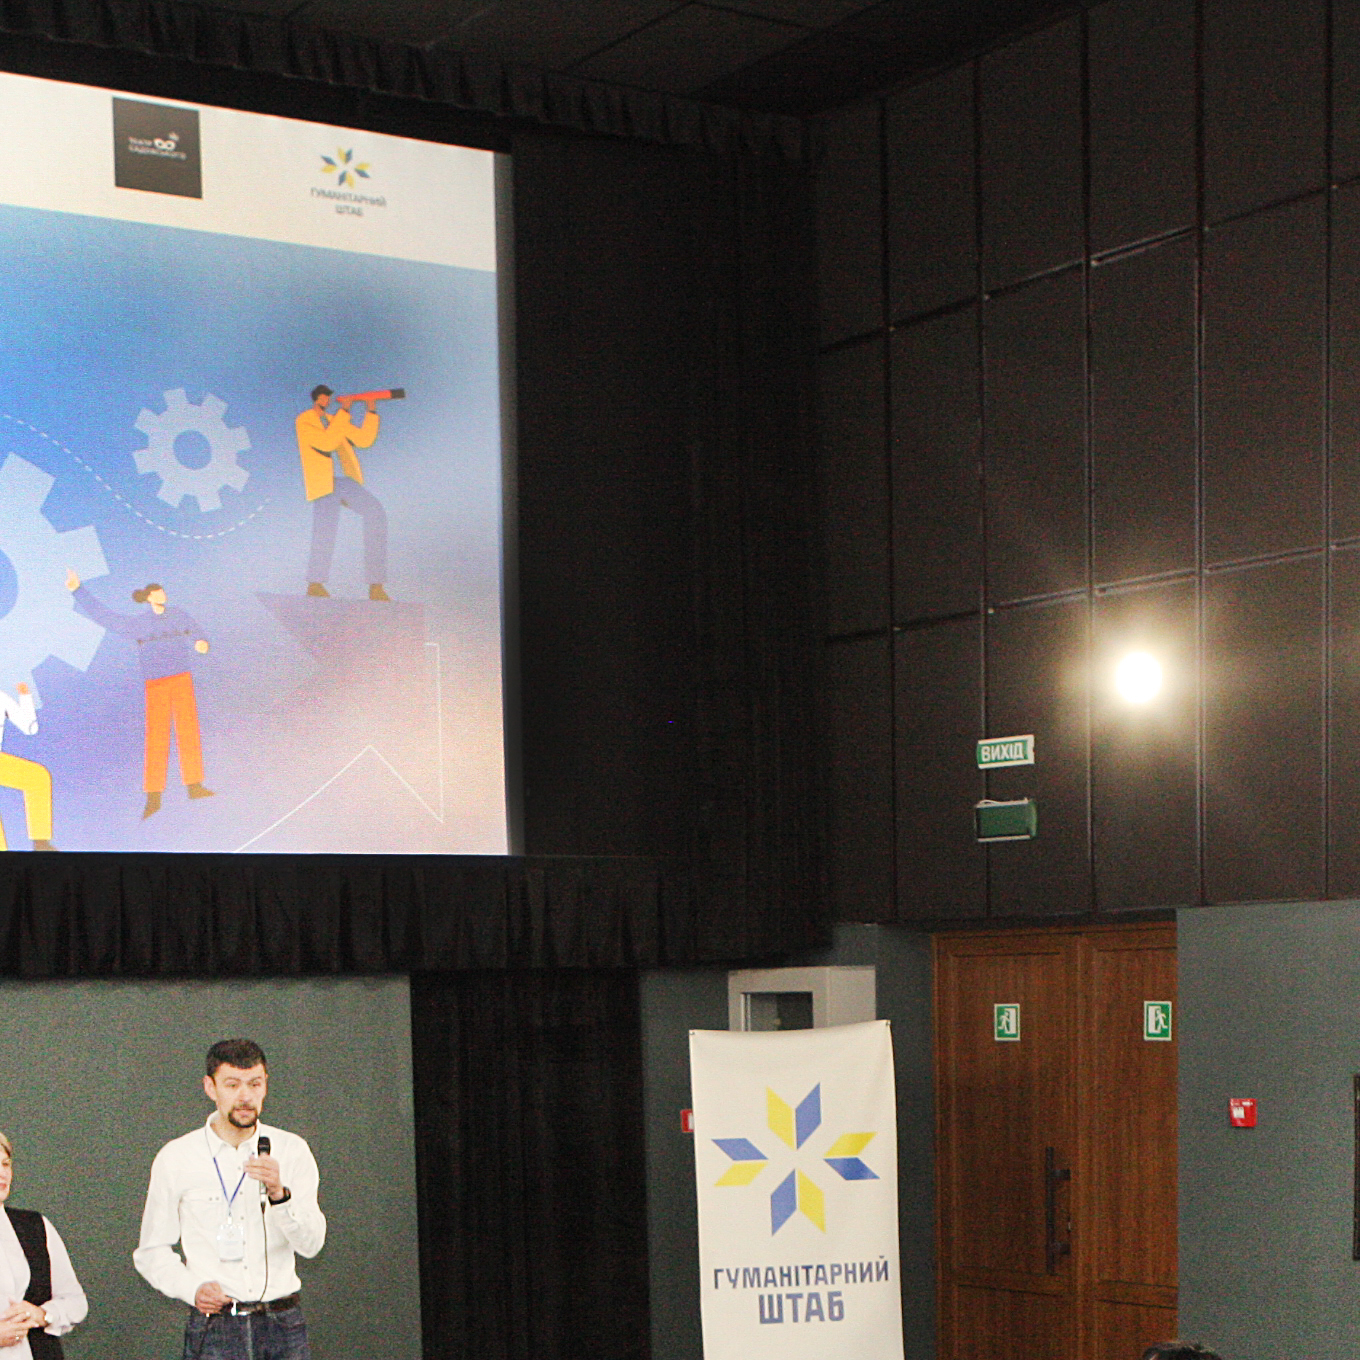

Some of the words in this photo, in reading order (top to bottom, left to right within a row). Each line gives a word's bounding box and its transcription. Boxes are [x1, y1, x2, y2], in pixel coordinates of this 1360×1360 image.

[981, 741, 1025, 762] ВИХІД
[713, 1255, 889, 1289] ГУМАНІТАРНИЙ
[758, 1291, 845, 1325] ШТАБ
